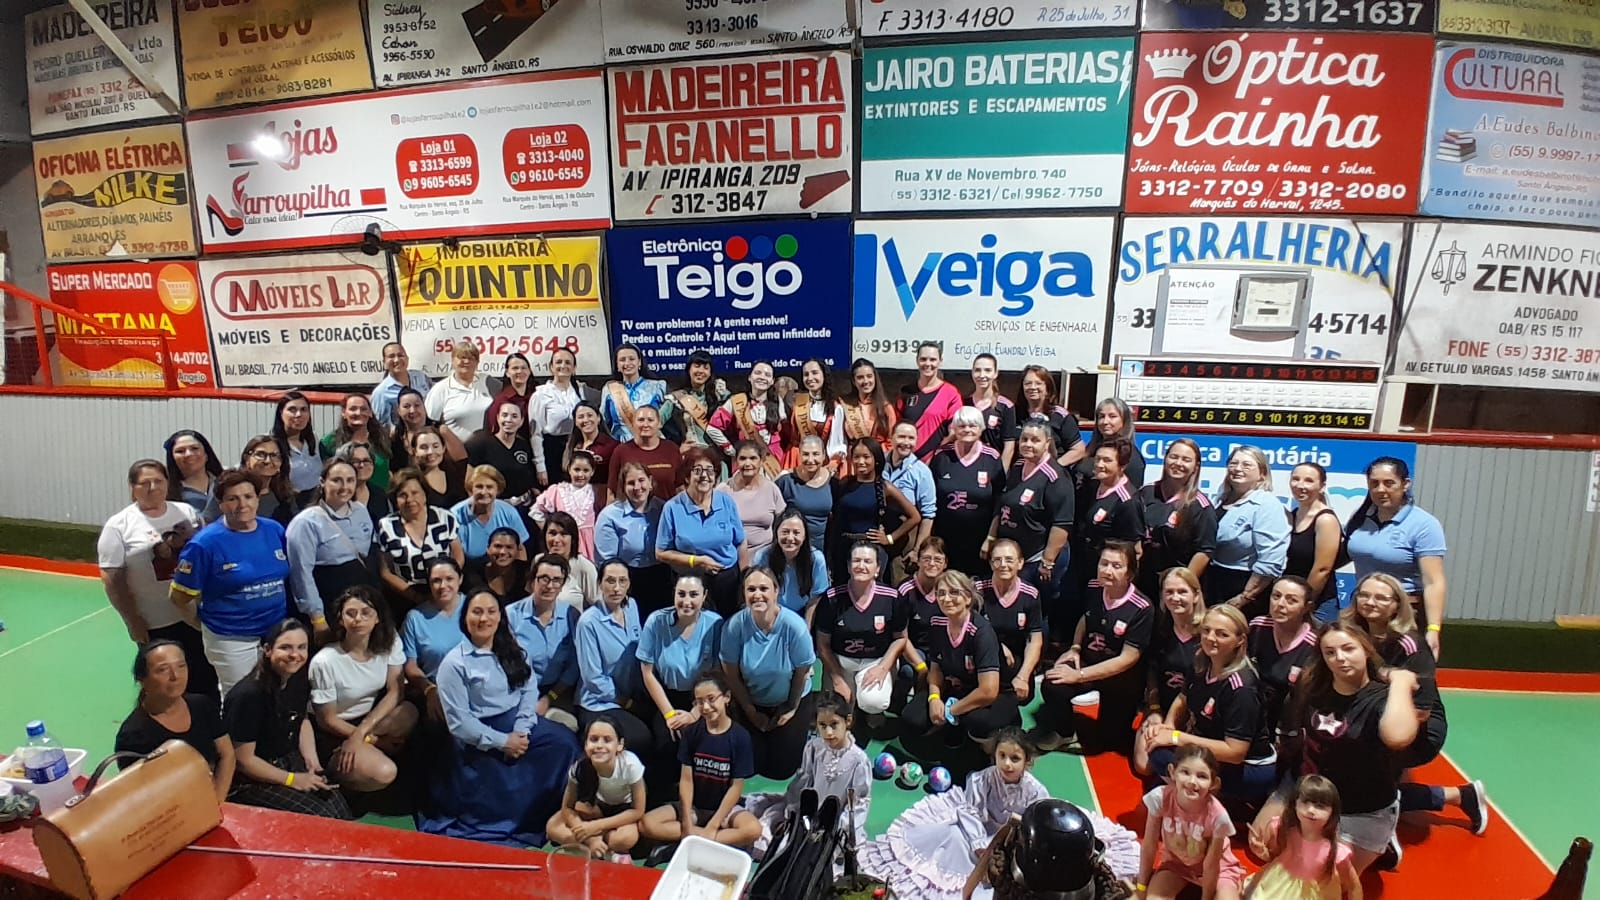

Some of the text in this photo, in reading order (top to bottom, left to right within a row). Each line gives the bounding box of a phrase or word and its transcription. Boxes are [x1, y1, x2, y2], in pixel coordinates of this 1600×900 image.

[1048, 7, 1064, 21] 25
[1112, 5, 1130, 20] 31
[1263, 0, 1424, 26] 3312-1637
[138, 36, 164, 51] Ltda
[626, 42, 666, 56] OSWALDO
[668, 40, 691, 52] CRUZ
[694, 38, 716, 50] 560
[766, 31, 798, 44] SANTO
[311, 48, 355, 64] ACESSÓRIOS
[1478, 49, 1565, 67] DISTRIBUIDORA
[461, 63, 488, 76] SANTO
[528, 58, 540, 69] RS
[865, 50, 1119, 92] JAIRO BATERIAS
[1202, 32, 1385, 99] Óptica
[614, 56, 845, 113] MADEIREIRA
[1444, 48, 1564, 106] CULTURAL
[865, 96, 1107, 120] EXTINTORES E ESCAPAMENTOS
[1133, 85, 1381, 148] Rainha
[420, 138, 456, 154] Loja 01
[530, 130, 568, 147] Loja 02
[616, 114, 842, 168] FAGANELLO
[38, 135, 183, 179] OFICINA ELÉTRICA
[528, 148, 584, 166] 3313-4040
[1508, 145, 1535, 158] (55)
[420, 156, 472, 173] 3313-6599
[420, 174, 473, 190] 9605-6545
[528, 166, 584, 182] 9610-6545
[760, 164, 801, 186] 209
[895, 168, 1067, 182] Rua XV de 740
[1139, 179, 1407, 200] 3312-7709 3312-2080
[671, 190, 768, 214] 312-3847
[1189, 197, 1237, 212] Marquês
[1243, 198, 1257, 209] do
[1260, 197, 1306, 212] Herval,
[139, 207, 173, 223] PAINÉIS
[642, 239, 722, 254] Eletrônica
[1120, 221, 1392, 289] SERRALHERIA
[1481, 243, 1574, 264] ARMINDO
[51, 270, 152, 291] SUPER MERCADO
[419, 263, 592, 305] QUINTINO
[644, 252, 803, 310] Teigo
[882, 233, 1095, 322] Veiga
[229, 275, 370, 313] MÓVEIS LAR
[404, 312, 598, 332] VENDA E LOCAÇÃO DE IMÓVEIS
[1514, 306, 1578, 321] ADVOGADO
[621, 319, 634, 331] TV
[635, 320, 654, 331] com
[656, 317, 705, 332] problemas
[714, 316, 722, 327] A
[723, 317, 750, 330] gente
[752, 314, 789, 327] resolve!
[974, 319, 1098, 333] SERVIÇOS DE ENGENHARIA
[218, 322, 391, 346] MÓVEIS E DECORAÇÕES
[622, 333, 655, 345] Perdeu
[657, 335, 663, 343] o
[664, 332, 704, 343] Controle
[713, 330, 736, 344] Aqui
[737, 331, 756, 341] tem
[758, 331, 780, 341] uma
[655, 346, 687, 357] muitos
[1028, 344, 1056, 357] VEIGA
[1447, 340, 1528, 359] FONE (55)
[351, 361, 357, 373] E
[734, 359, 752, 370] Rua
[1130, 363, 1137, 373] 1
[1180, 365, 1189, 375] 4
[1420, 360, 1584, 382] GETÚLIO SANTO
[1141, 408, 1366, 426] 2 3 4 5 6 7 8 9 10 11 12 13 14 15
